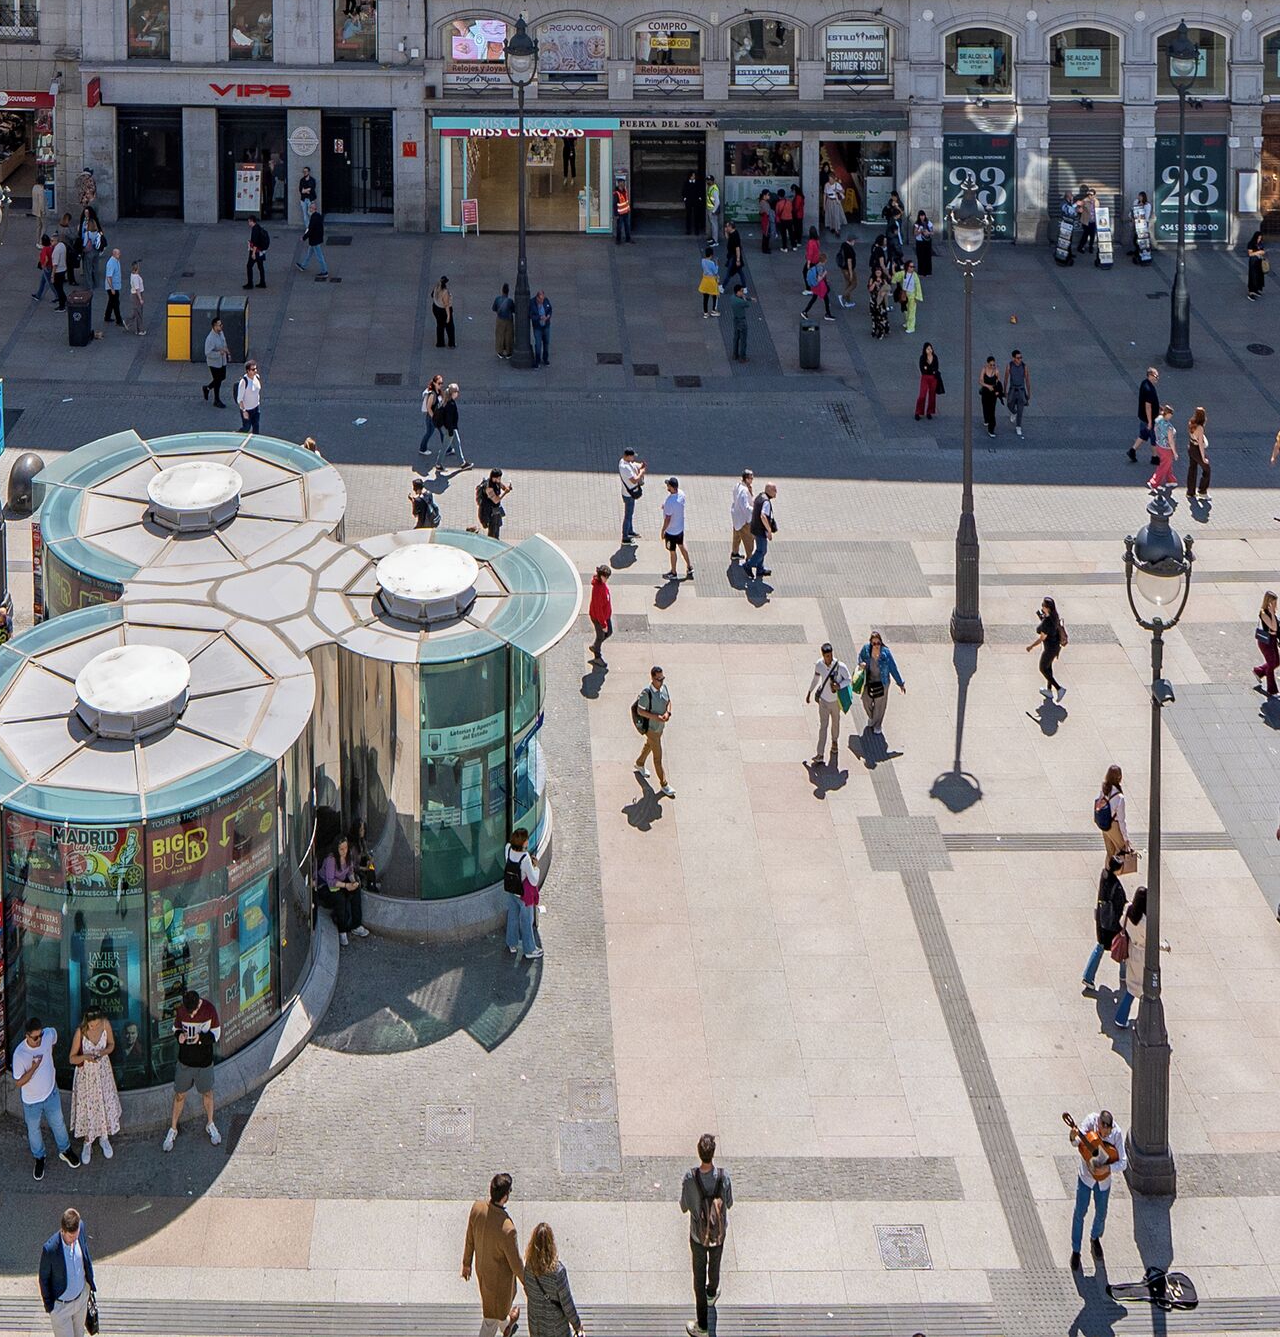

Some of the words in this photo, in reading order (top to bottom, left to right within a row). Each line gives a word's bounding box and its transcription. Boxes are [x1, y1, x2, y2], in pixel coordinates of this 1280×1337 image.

[648, 21, 688, 31] COMPRO
[827, 51, 864, 62] ¡ESTAMOS
[452, 64, 480, 73] Relojes
[486, 64, 506, 73] Joyas
[641, 66, 669, 74] Relojes
[674, 66, 696, 74] Joyas
[830, 61, 859, 71] PRIMER
[859, 61, 881, 71] PISO!
[209, 83, 292, 98] VIPS
[479, 119, 506, 128] MISS
[507, 119, 574, 128] CARCASAS
[620, 120, 657, 128] PUERTA
[661, 120, 680, 128] DEL
[683, 120, 702, 128] SOL
[470, 128, 503, 138] MISS
[506, 128, 585, 138] CARCASAS
[1160, 165, 1219, 206] 23
[182, 806, 210, 821] TICKETS
[152, 819, 176, 828] TOURS
[51, 826, 119, 846] MADRID
[72, 843, 91, 854] City
[91, 843, 116, 853] Tour
[152, 833, 184, 858] BIG
[153, 851, 185, 874] BUS
[171, 866, 193, 875] MADRID
[27, 880, 51, 892] REVISTA
[74, 889, 109, 897] REFRESCOS
[35, 912, 59, 924] REVISTAS
[40, 923, 61, 935] BEBIDAS
[88, 951, 121, 960] JAVIER
[88, 960, 121, 969] SIERRA
